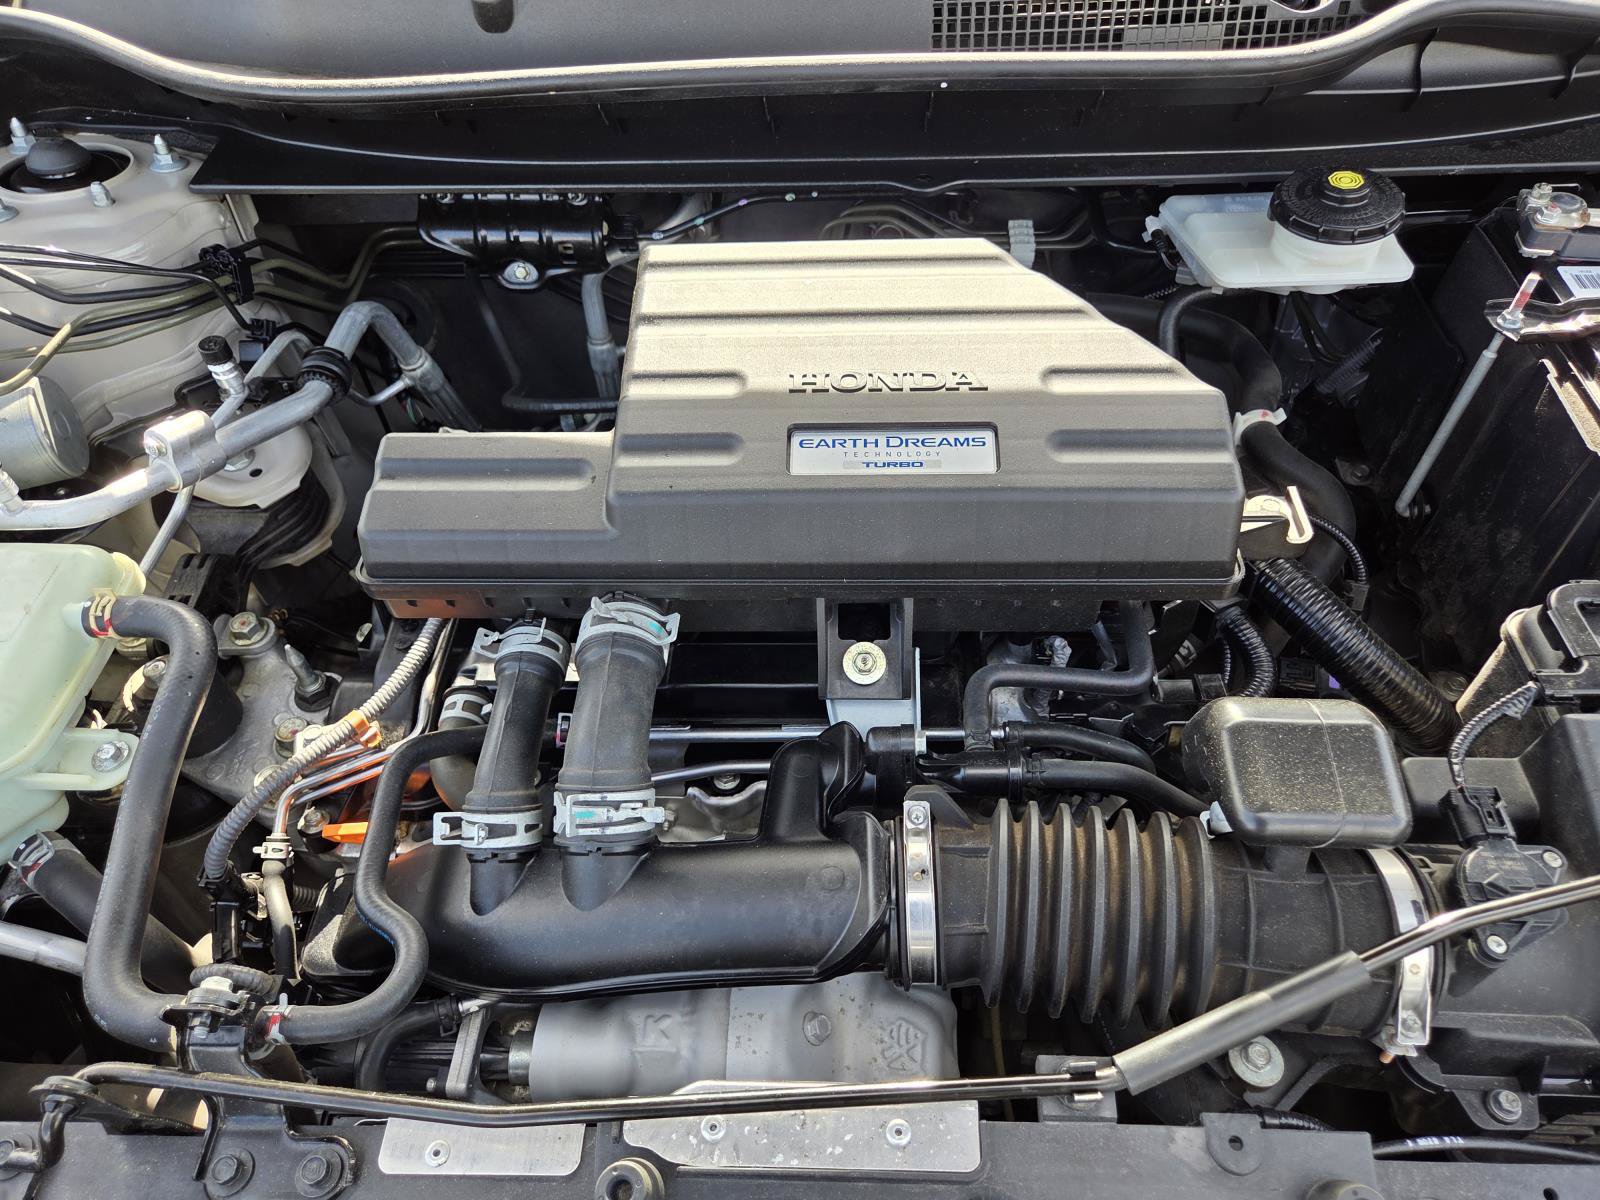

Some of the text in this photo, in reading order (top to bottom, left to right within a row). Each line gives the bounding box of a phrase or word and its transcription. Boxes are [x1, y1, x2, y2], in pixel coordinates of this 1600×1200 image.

[788, 371, 989, 393] HONDA
[799, 436, 986, 449] EARTH DREAMS
